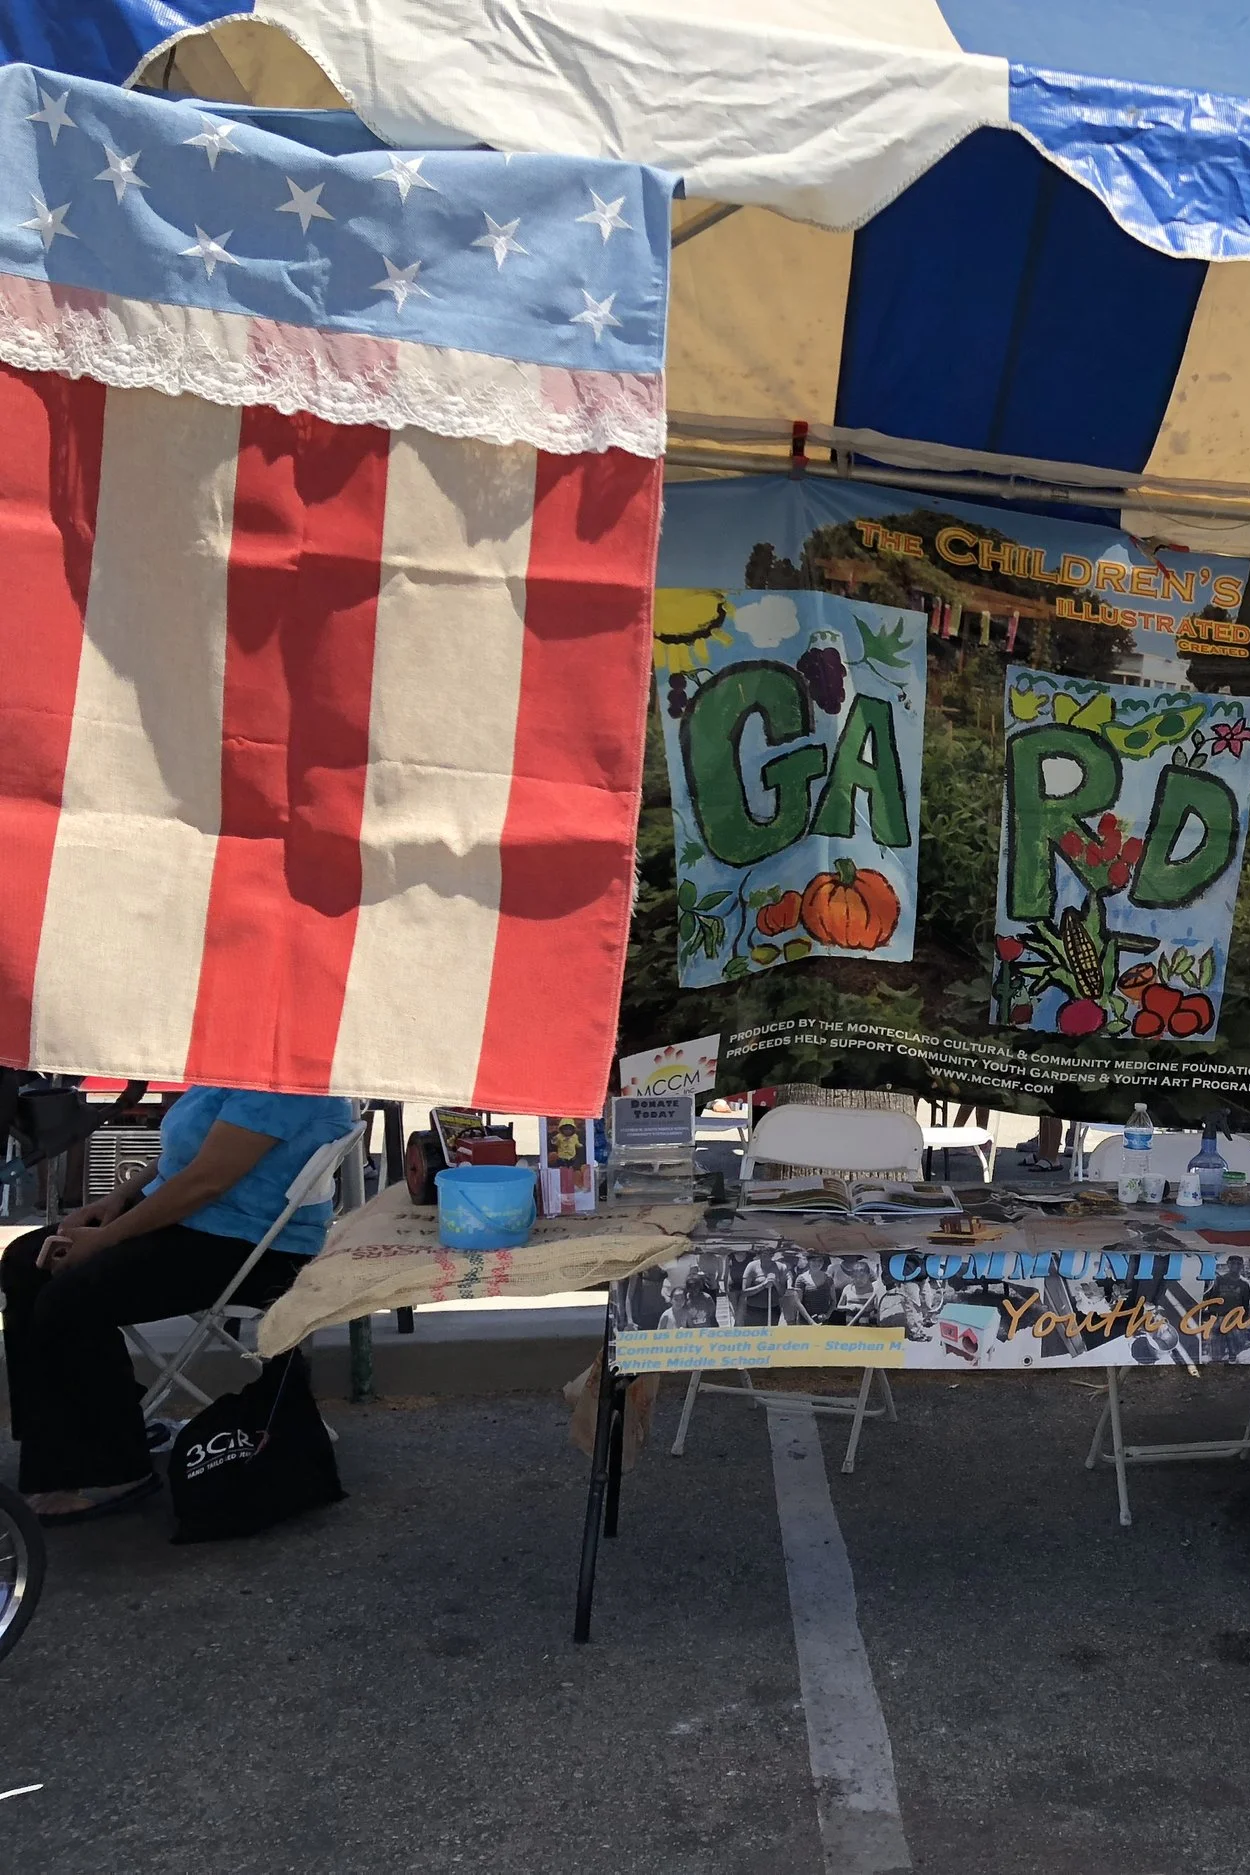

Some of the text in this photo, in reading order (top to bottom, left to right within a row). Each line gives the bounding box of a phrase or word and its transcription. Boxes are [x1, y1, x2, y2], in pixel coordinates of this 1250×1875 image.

[856, 520, 924, 557] THE
[935, 526, 1242, 609] CHILDREN'S
[1056, 597, 1250, 646] ILLUSTRATED
[1176, 639, 1248, 658] CREATED
[729, 1019, 795, 1043] PRODUCED
[799, 1018, 816, 1028] BY
[819, 1021, 843, 1031] THE
[847, 1023, 939, 1046] MONTECLARO
[943, 1039, 1017, 1059] CULTURAL
[1017, 1050, 1028, 1060] &
[1031, 1053, 1111, 1069] COMMUNITY
[1114, 1060, 1179, 1072] MEDICINE
[726, 1036, 791, 1059] PROCEEDS
[795, 1034, 827, 1045] HELP
[830, 1038, 894, 1053] SUPPORT
[897, 1044, 978, 1068] COMMUNITY
[982, 1058, 1026, 1076] YOUTH
[1029, 1068, 1096, 1083] GARDENS
[1099, 1073, 1110, 1083] &
[1114, 1073, 1158, 1085] YOUTH
[1160, 1076, 1190, 1087] ART
[637, 1070, 700, 1096] MCCM
[631, 1099, 679, 1109] DONATE
[634, 1110, 675, 1119] TODAY
[1002, 1293, 1166, 1340] Youth
[617, 1332, 648, 1342] Join
[653, 1332, 669, 1341] us
[675, 1331, 693, 1340] on
[618, 1344, 702, 1357] Community
[709, 1343, 751, 1353] Youth
[757, 1341, 809, 1351] Garden
[825, 1341, 884, 1352] Stephen
[667, 1356, 715, 1368] Middle
[721, 1355, 771, 1366] School
